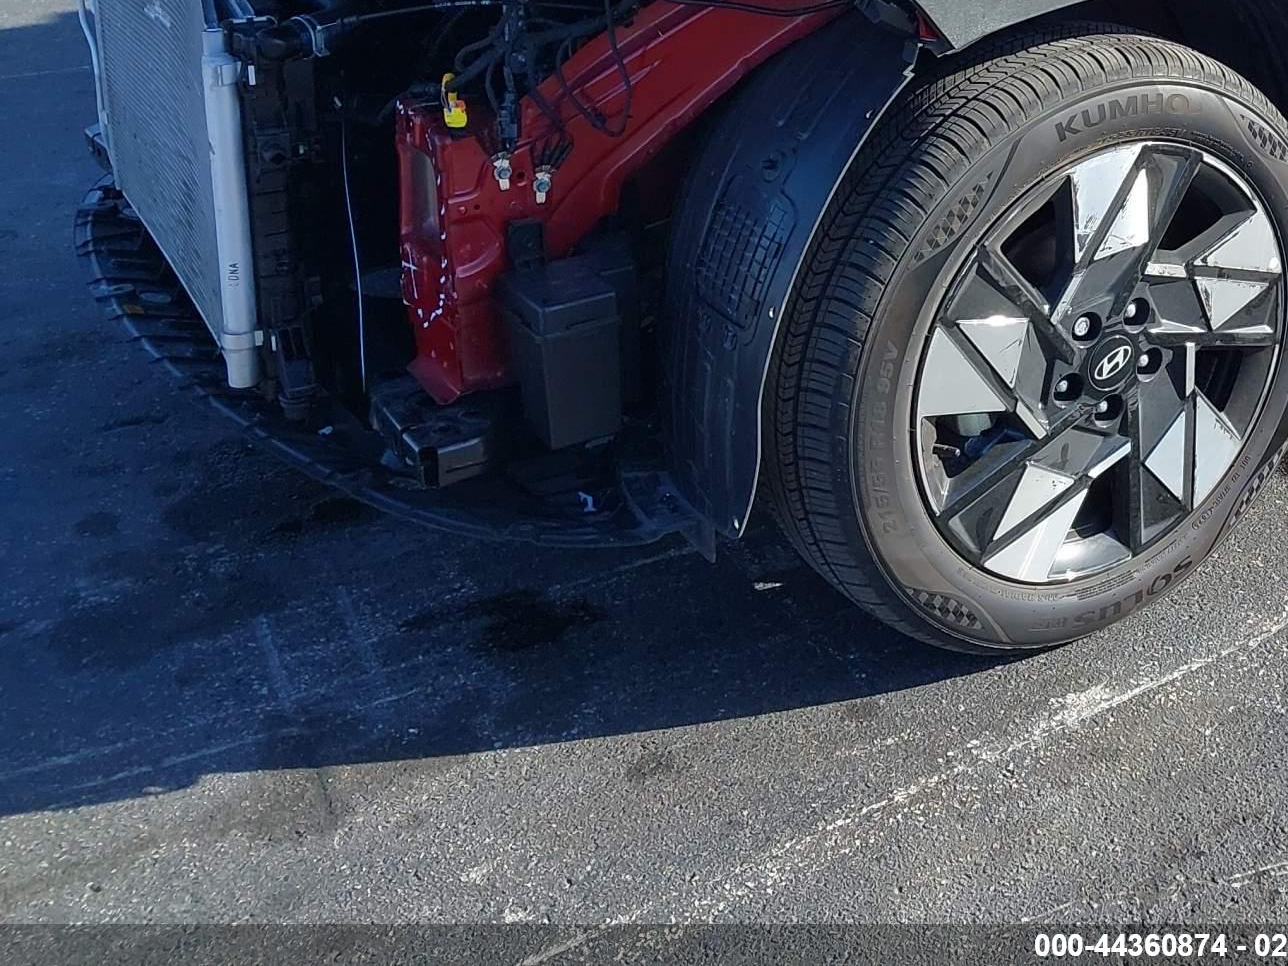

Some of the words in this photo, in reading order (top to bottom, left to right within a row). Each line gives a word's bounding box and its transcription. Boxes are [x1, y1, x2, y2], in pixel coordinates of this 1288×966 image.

[1054, 92, 1191, 143] KUMHO
[876, 340, 898, 395] 95V
[871, 457, 898, 534] 215/55
[1074, 555, 1193, 627] SOLUS
